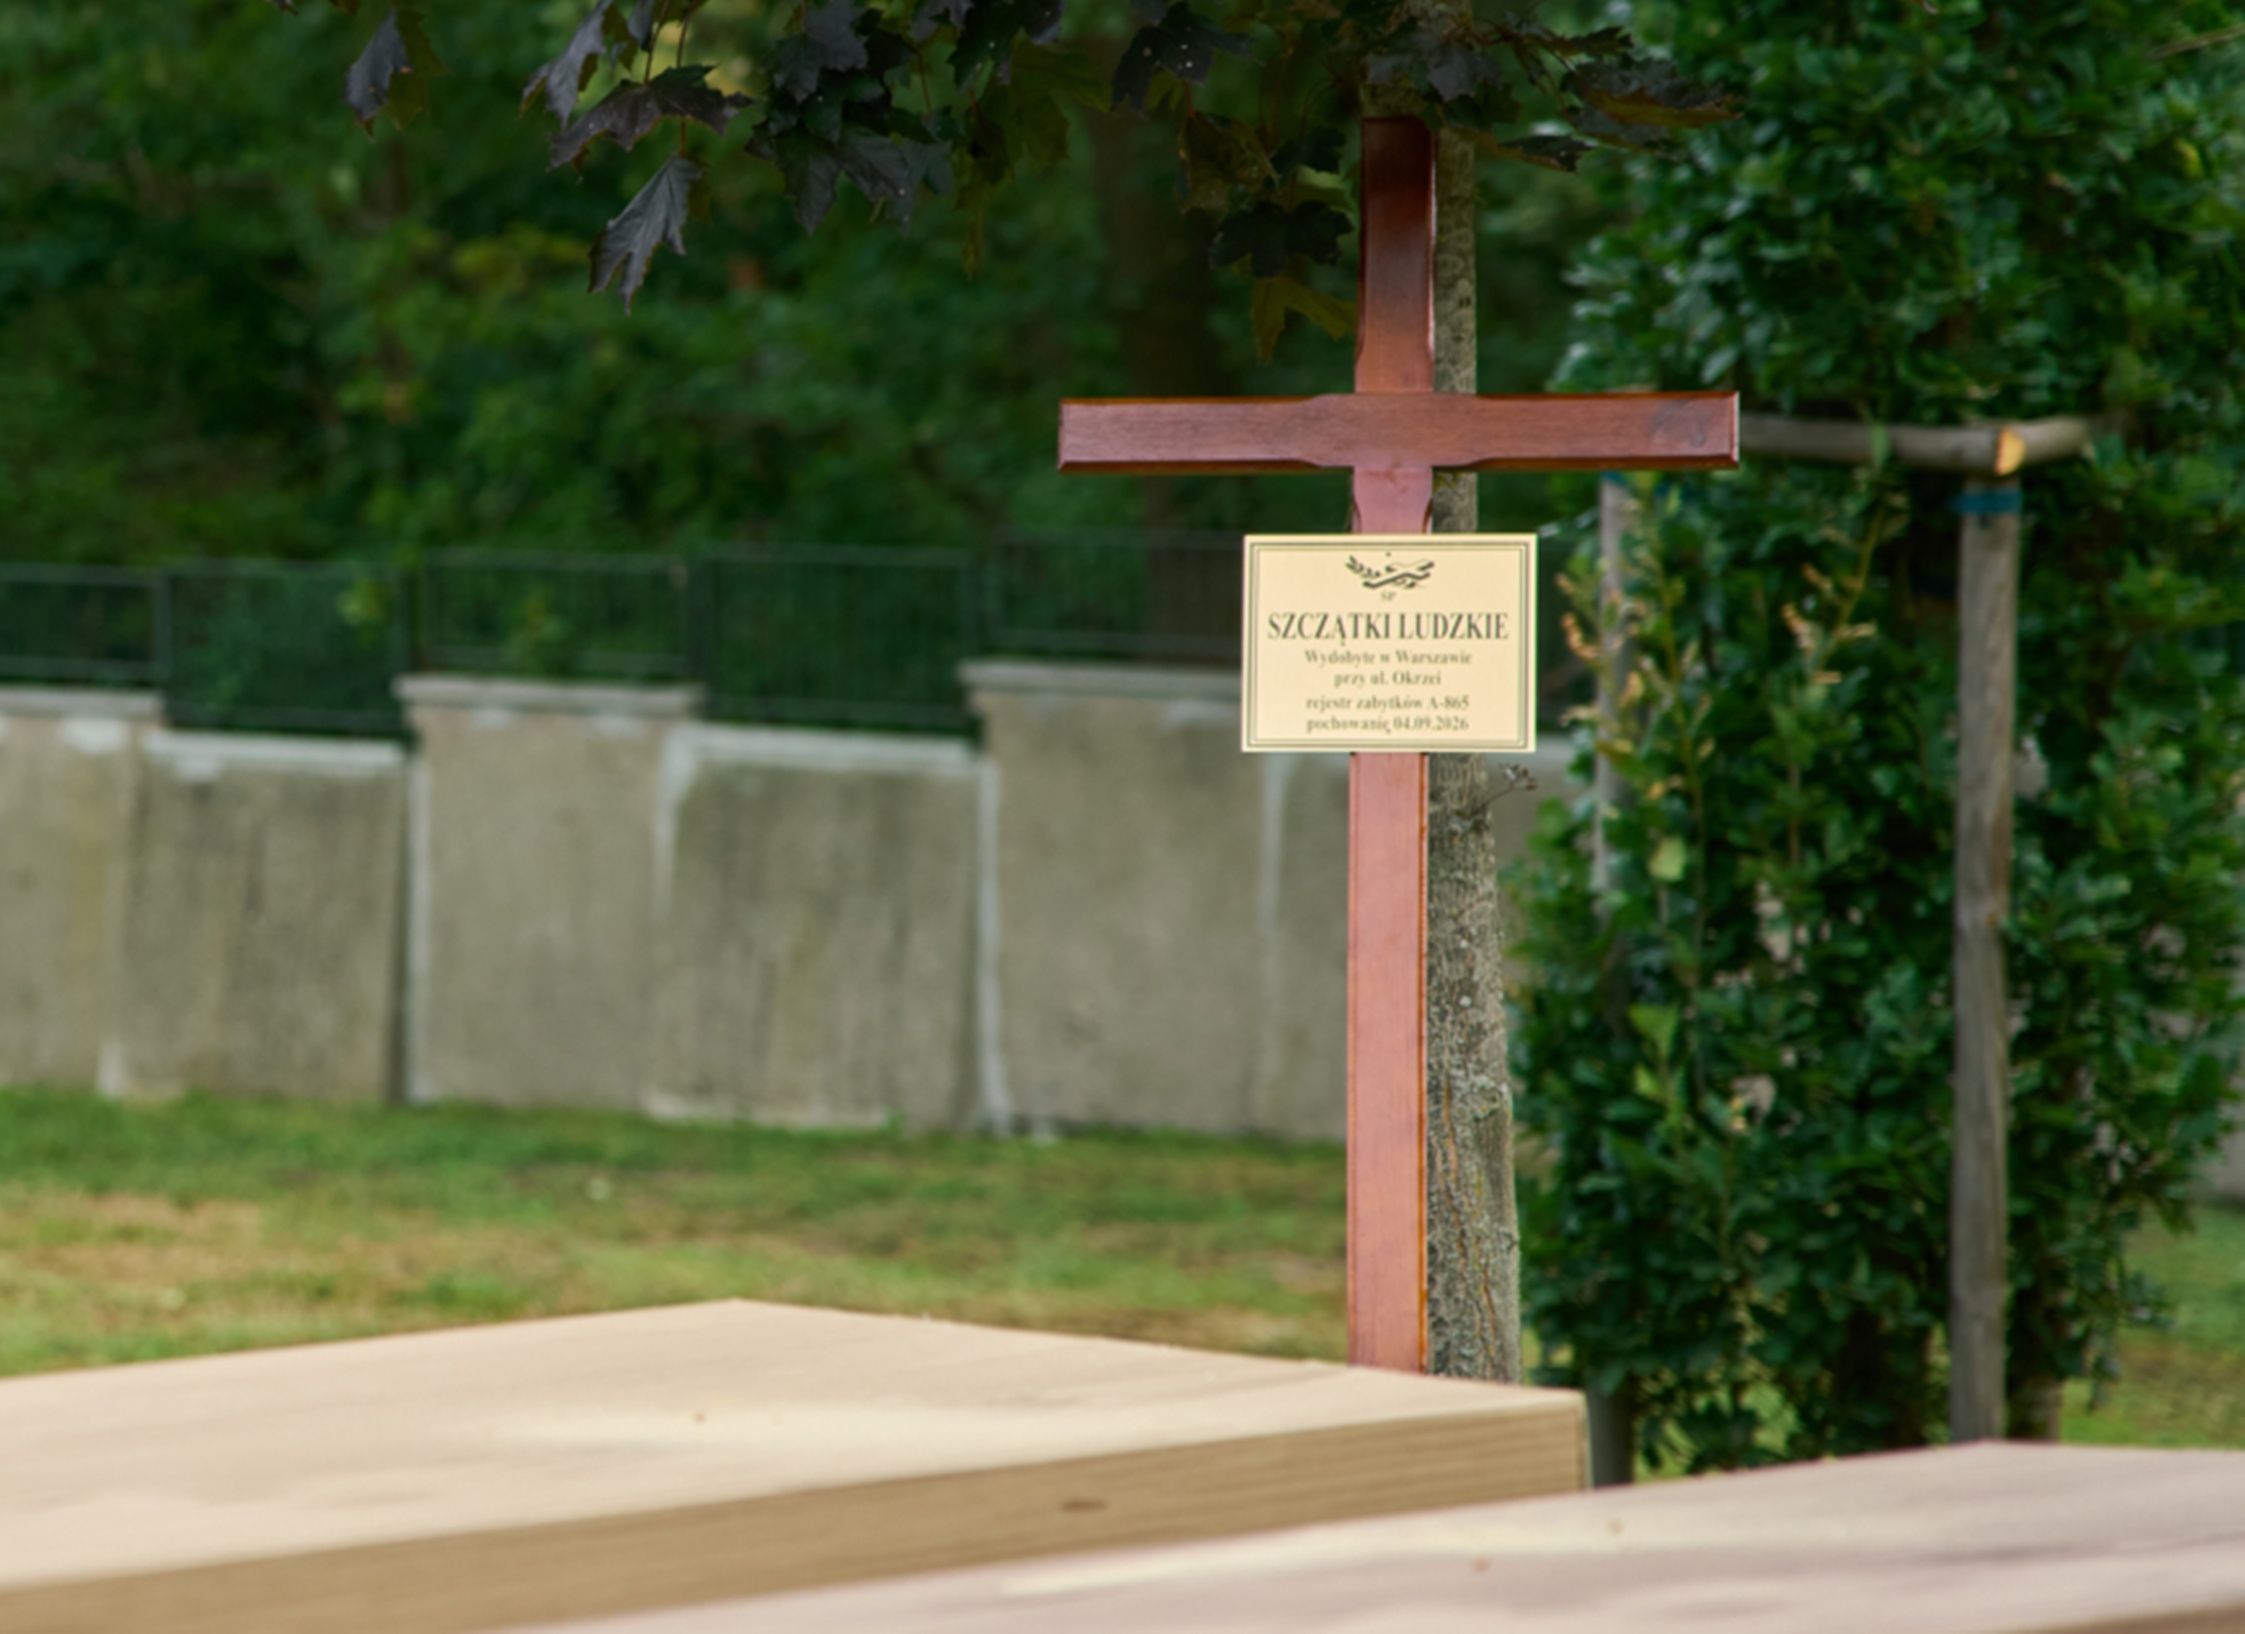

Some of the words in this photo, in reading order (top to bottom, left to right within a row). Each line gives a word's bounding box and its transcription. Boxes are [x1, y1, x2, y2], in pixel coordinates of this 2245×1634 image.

[1267, 612, 1390, 646] SZCZĄTKI
[1399, 612, 1509, 640] LUDZKIE
[1305, 649, 1375, 668] Wydobyte
[1380, 653, 1390, 664] w
[1395, 649, 1472, 665] Warszawie
[1334, 673, 1365, 689] przy
[1370, 670, 1389, 685] ul.
[1392, 670, 1442, 685] Okrzei
[1306, 694, 1352, 713] rejestr
[1356, 694, 1422, 713] zabytków
